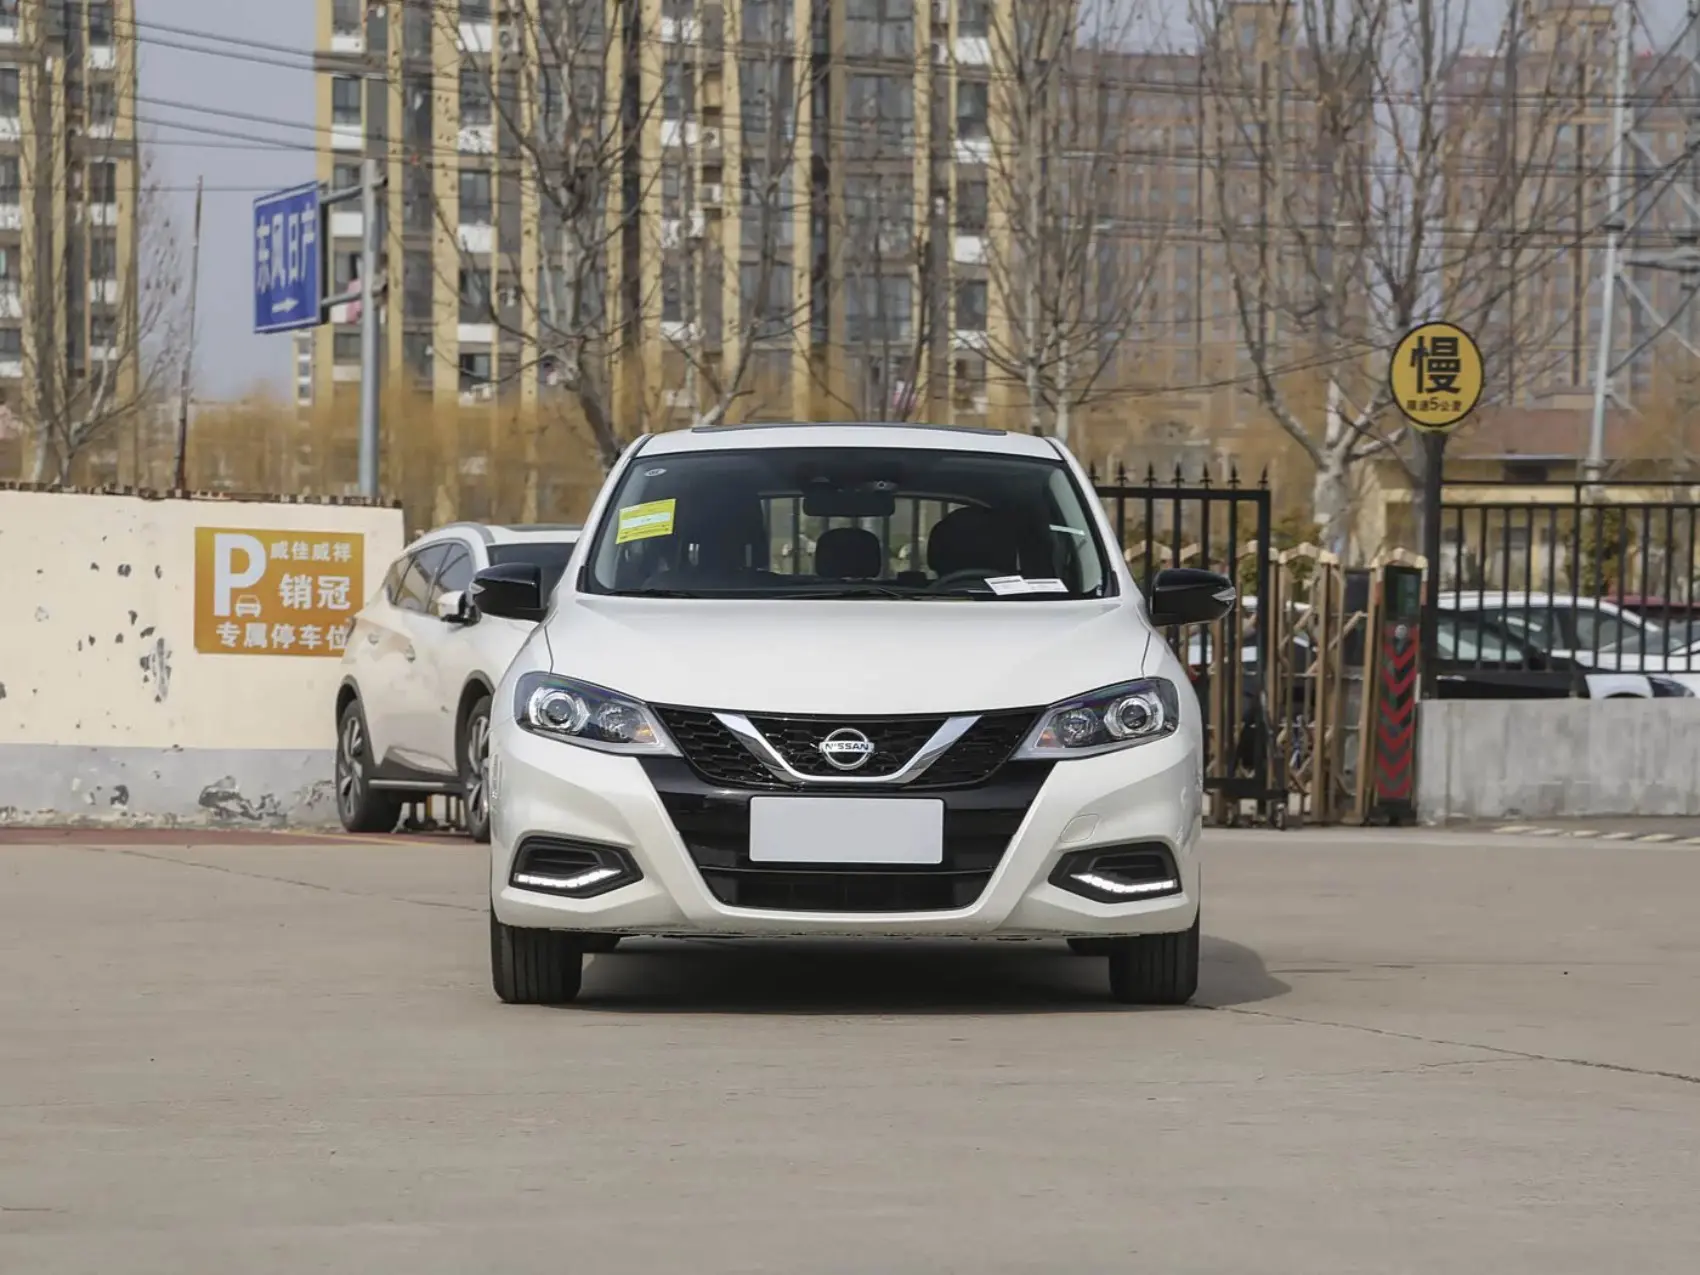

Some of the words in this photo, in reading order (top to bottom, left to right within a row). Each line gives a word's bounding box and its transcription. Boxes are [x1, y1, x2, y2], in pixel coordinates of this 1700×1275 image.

[256, 201, 316, 295] 东风日产
[1409, 335, 1462, 394] 慢
[213, 532, 267, 617] P
[278, 572, 352, 610] 销冠
[215, 621, 348, 651] 专属停车位
[825, 742, 869, 751] NISSAN
